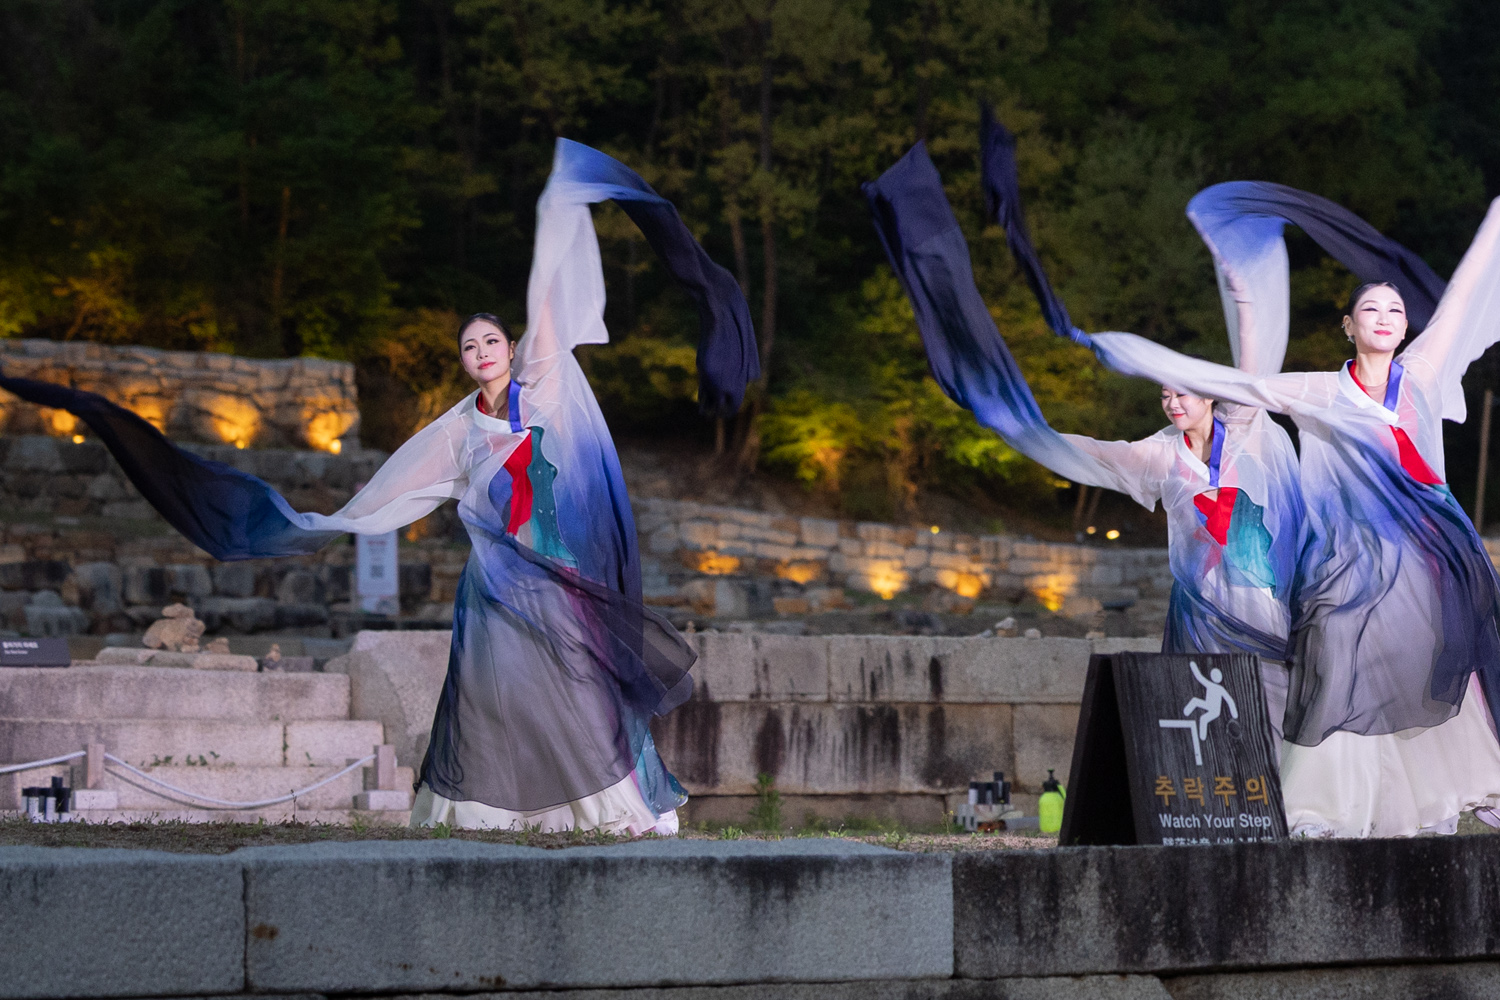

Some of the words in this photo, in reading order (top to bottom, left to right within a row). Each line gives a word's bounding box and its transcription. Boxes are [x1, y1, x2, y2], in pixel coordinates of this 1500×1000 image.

[1155, 775, 1269, 807] 추락주의
[1159, 813, 1201, 828] Watch
[1203, 813, 1235, 828] Your
[1239, 813, 1271, 830] Step
